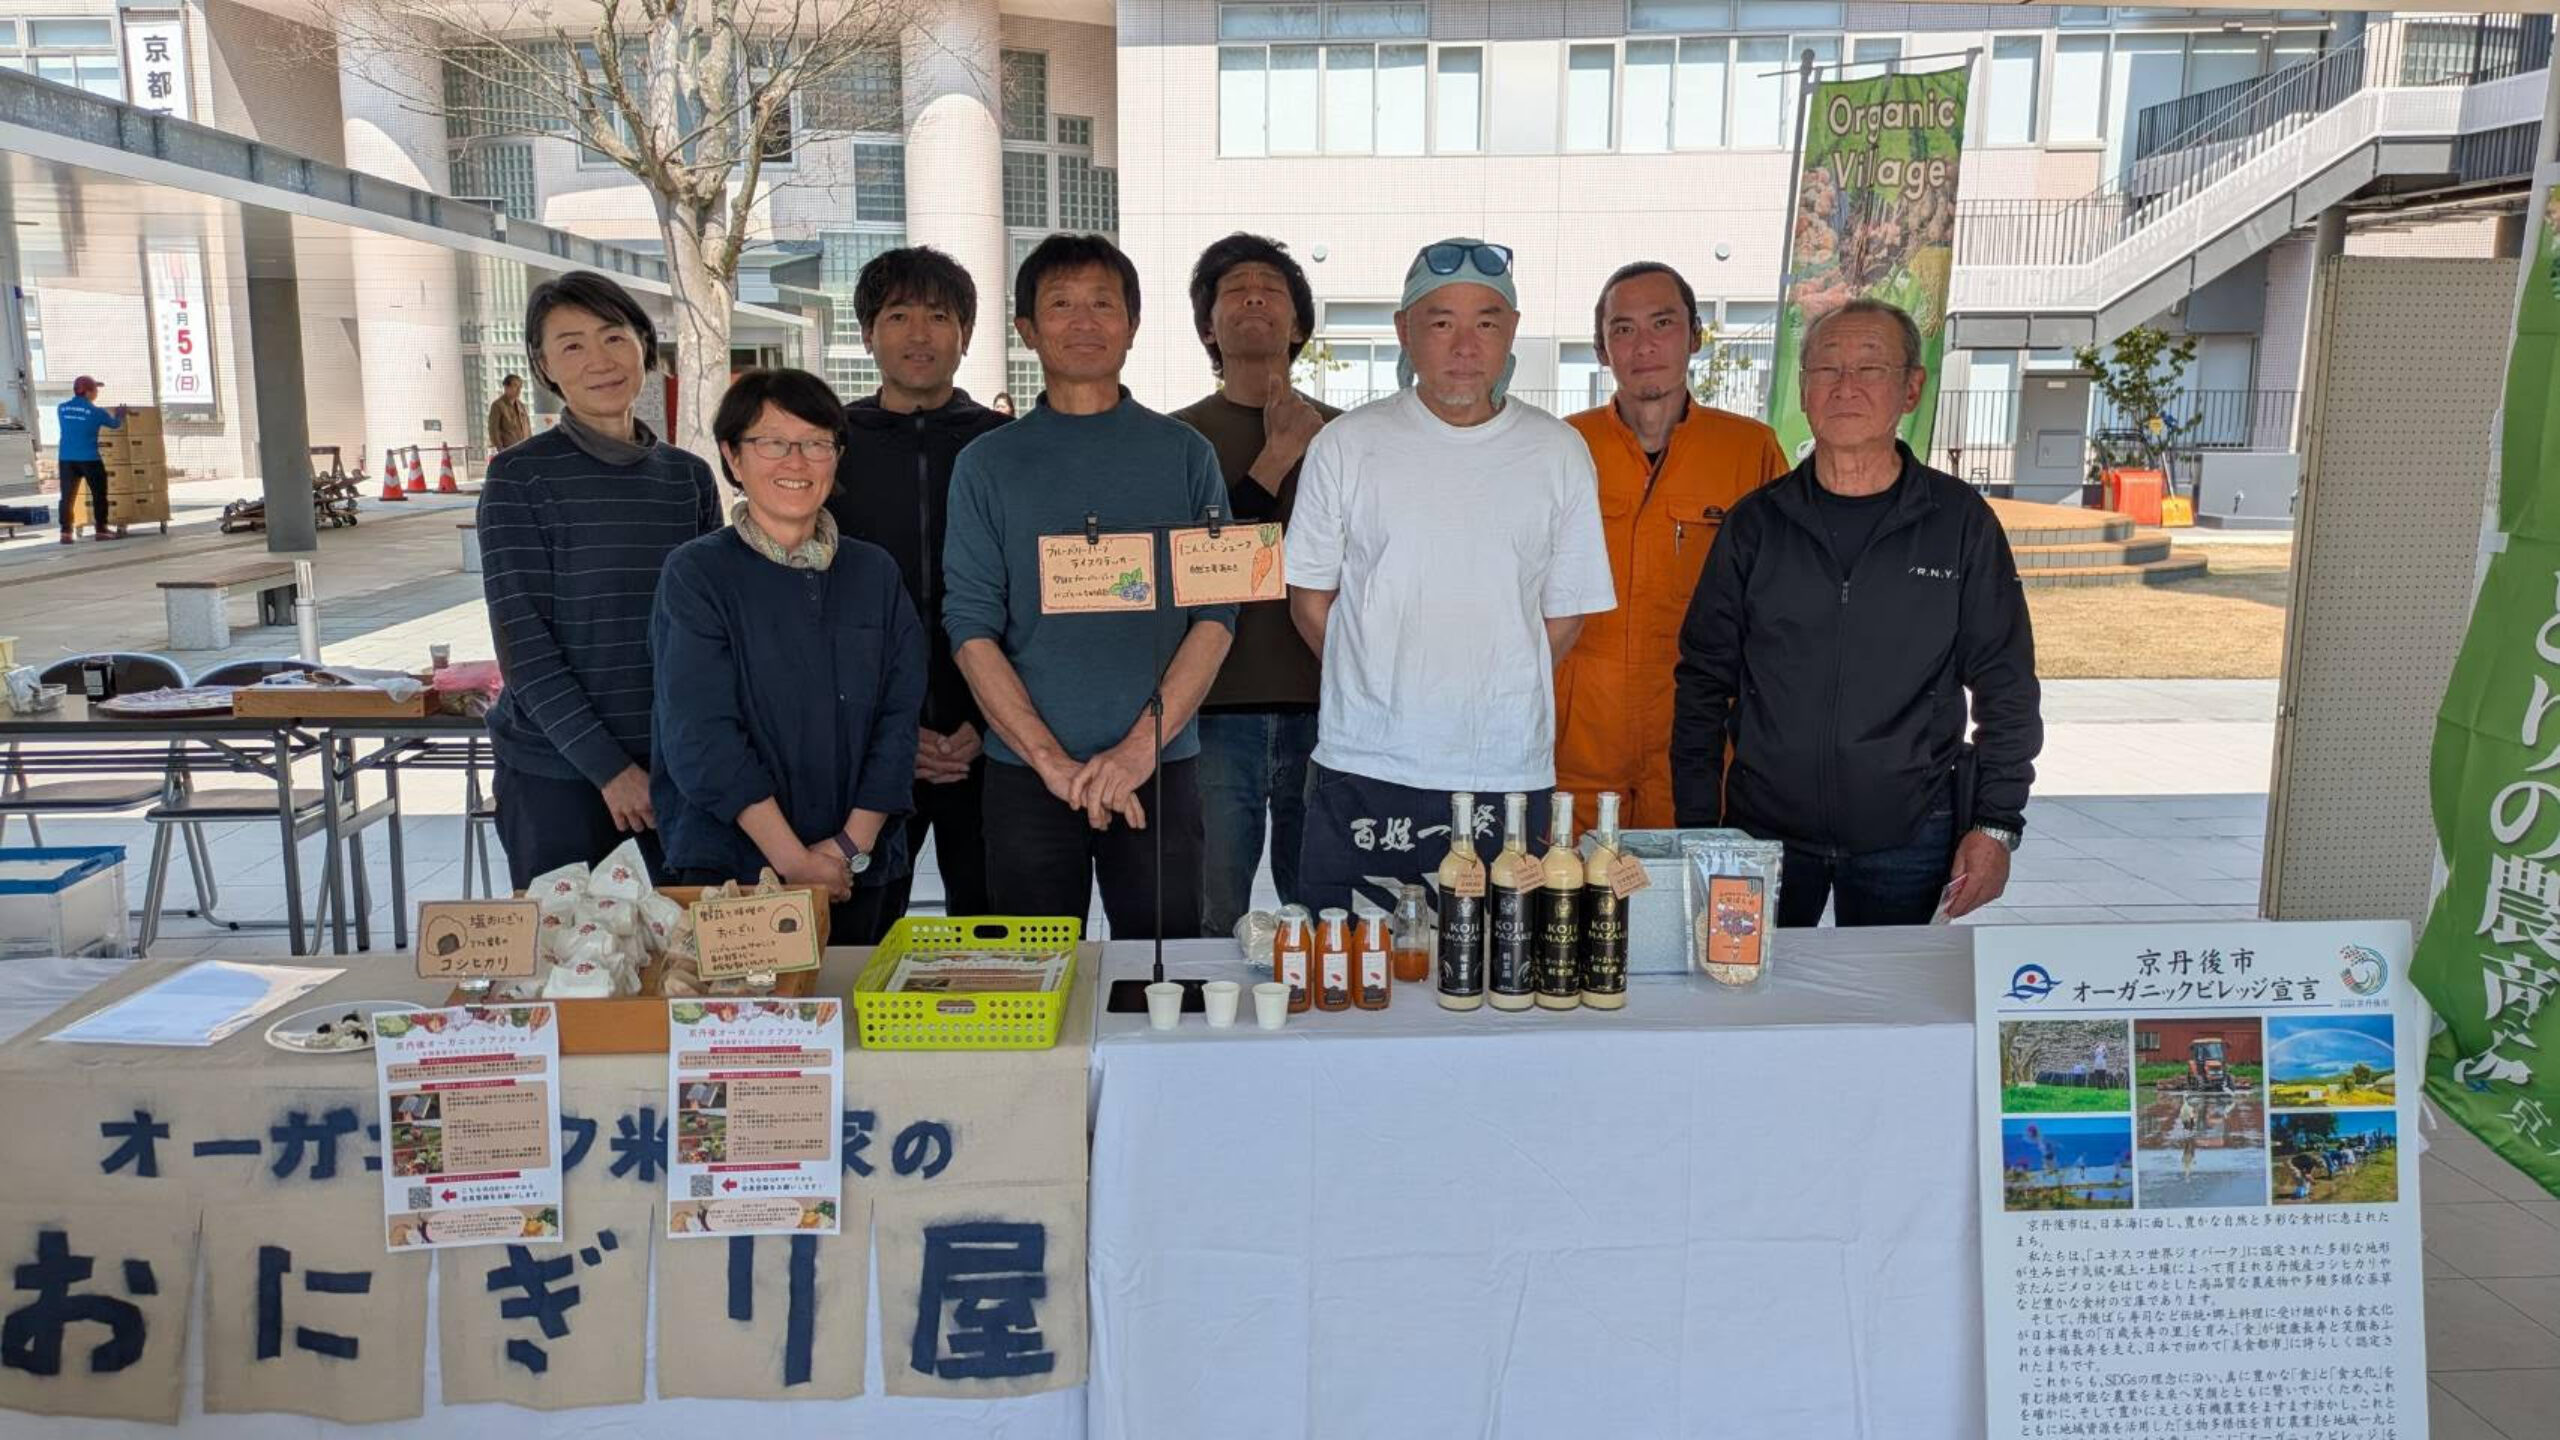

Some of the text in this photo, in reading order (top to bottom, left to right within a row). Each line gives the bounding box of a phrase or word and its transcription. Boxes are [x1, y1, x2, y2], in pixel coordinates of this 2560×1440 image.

[142, 35, 174, 116] 京都
[1829, 89, 1957, 143] Organic
[170, 300, 201, 393] 月5日(日)
[1591, 920, 1621, 931] KOJI
[438, 956, 509, 972] コシヒカリ
[2136, 947, 2256, 975] 京丹後市
[2072, 976, 2321, 1003] オーガニックビレッジ宣言
